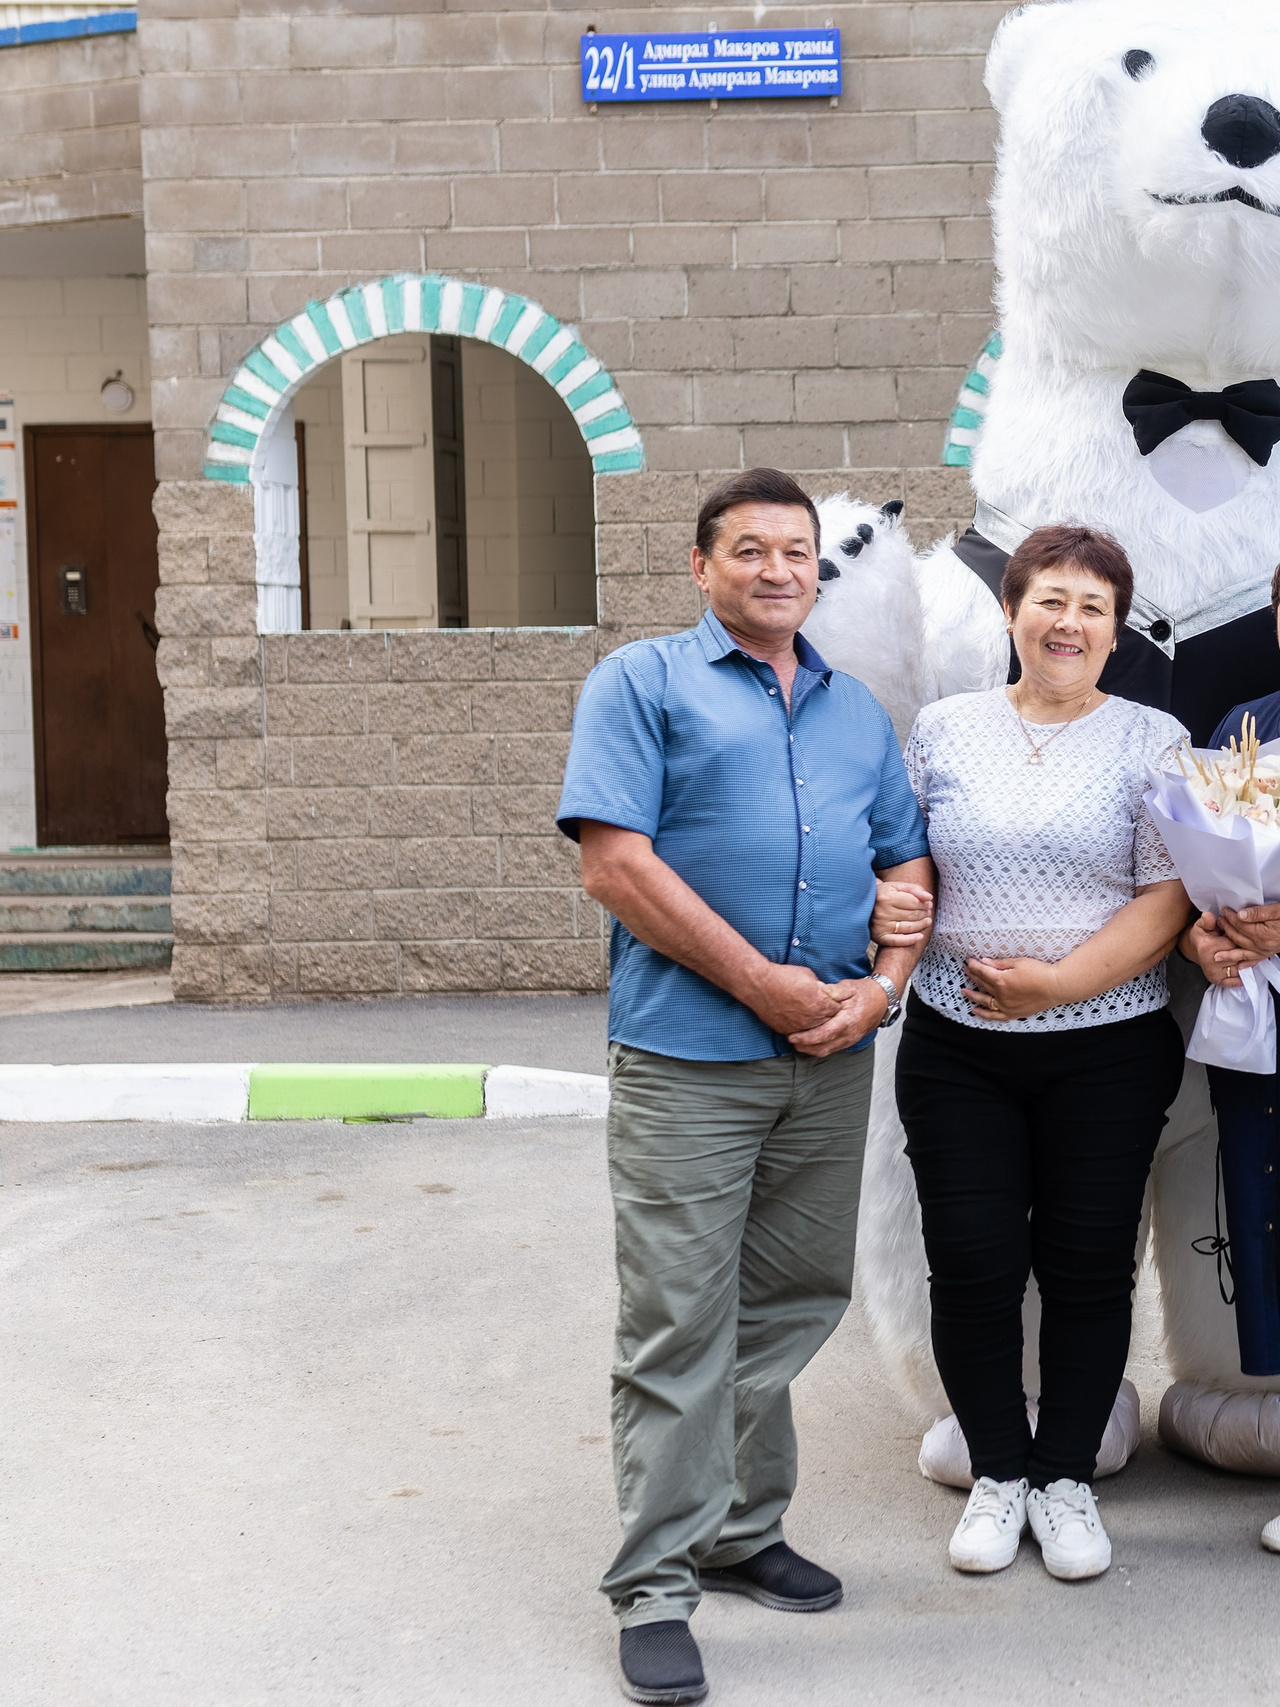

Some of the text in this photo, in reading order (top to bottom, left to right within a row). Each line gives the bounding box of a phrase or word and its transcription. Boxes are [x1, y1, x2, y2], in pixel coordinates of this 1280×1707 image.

[643, 39, 834, 63] Адмирал Макаров урамы
[585, 41, 636, 94] 22/1
[639, 66, 838, 93] улица Адмирала Макарова
